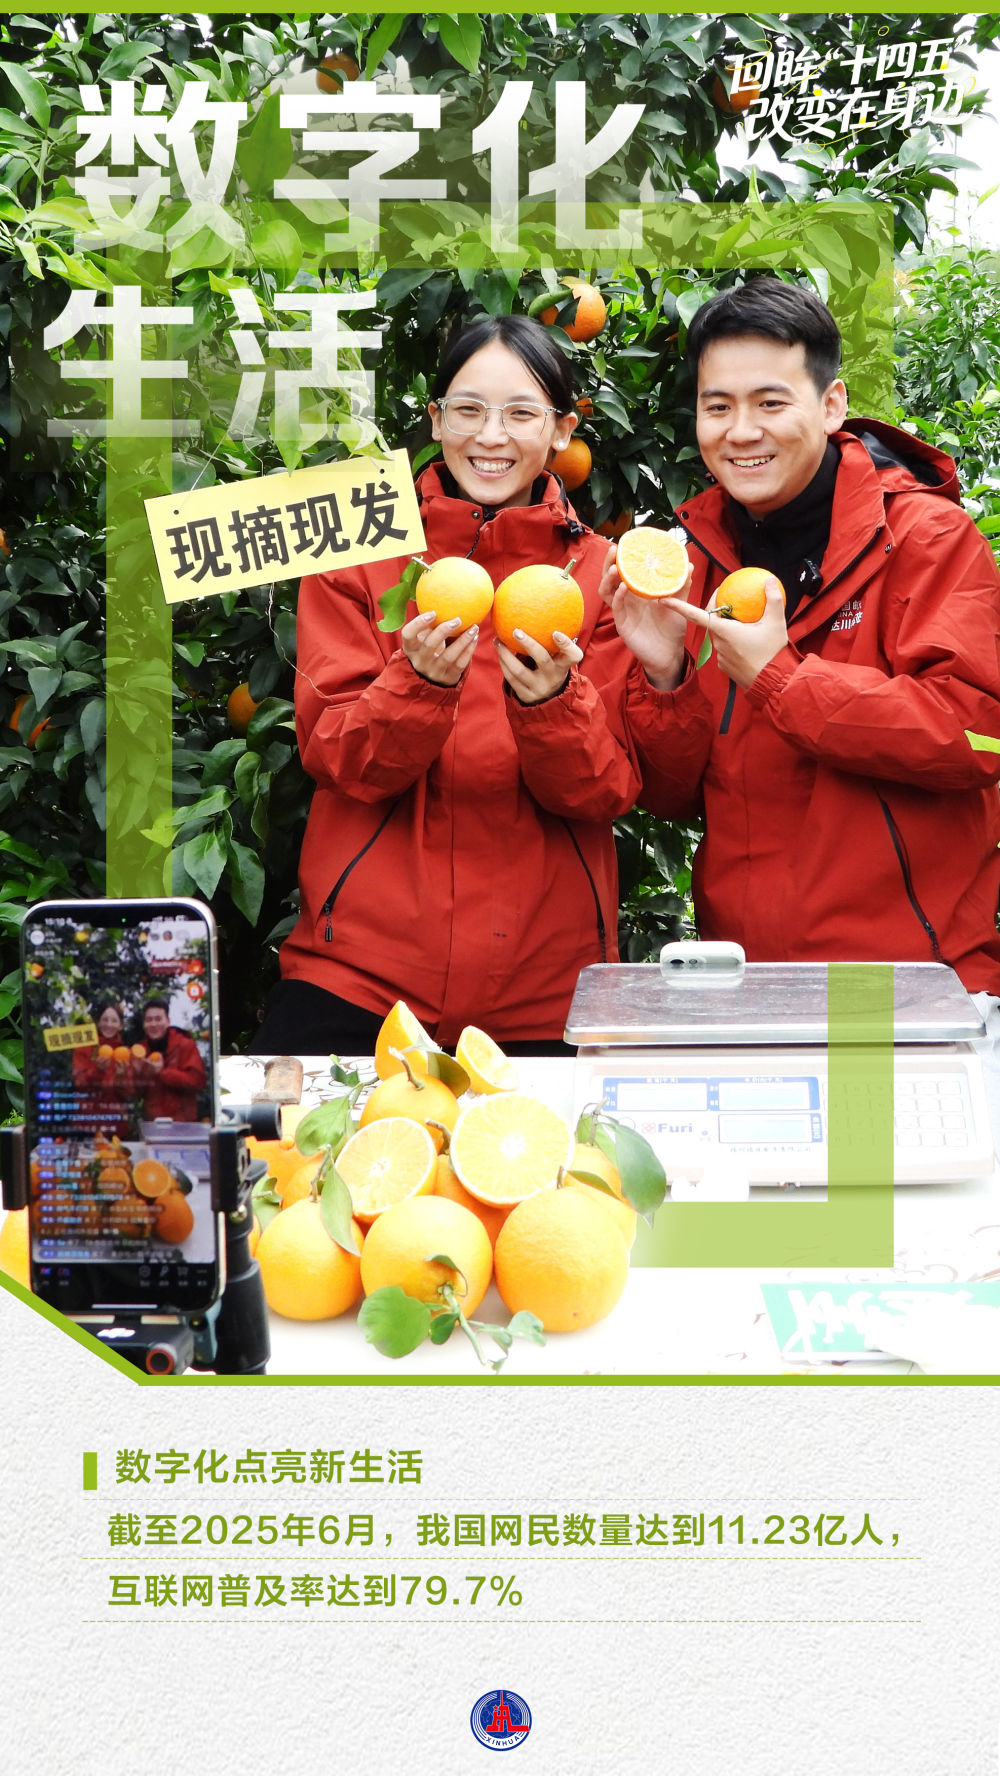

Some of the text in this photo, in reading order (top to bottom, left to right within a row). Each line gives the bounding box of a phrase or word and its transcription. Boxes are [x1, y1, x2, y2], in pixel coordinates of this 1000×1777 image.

[165, 480, 409, 584] 现摘现发
[657, 1122, 694, 1134] Furi
